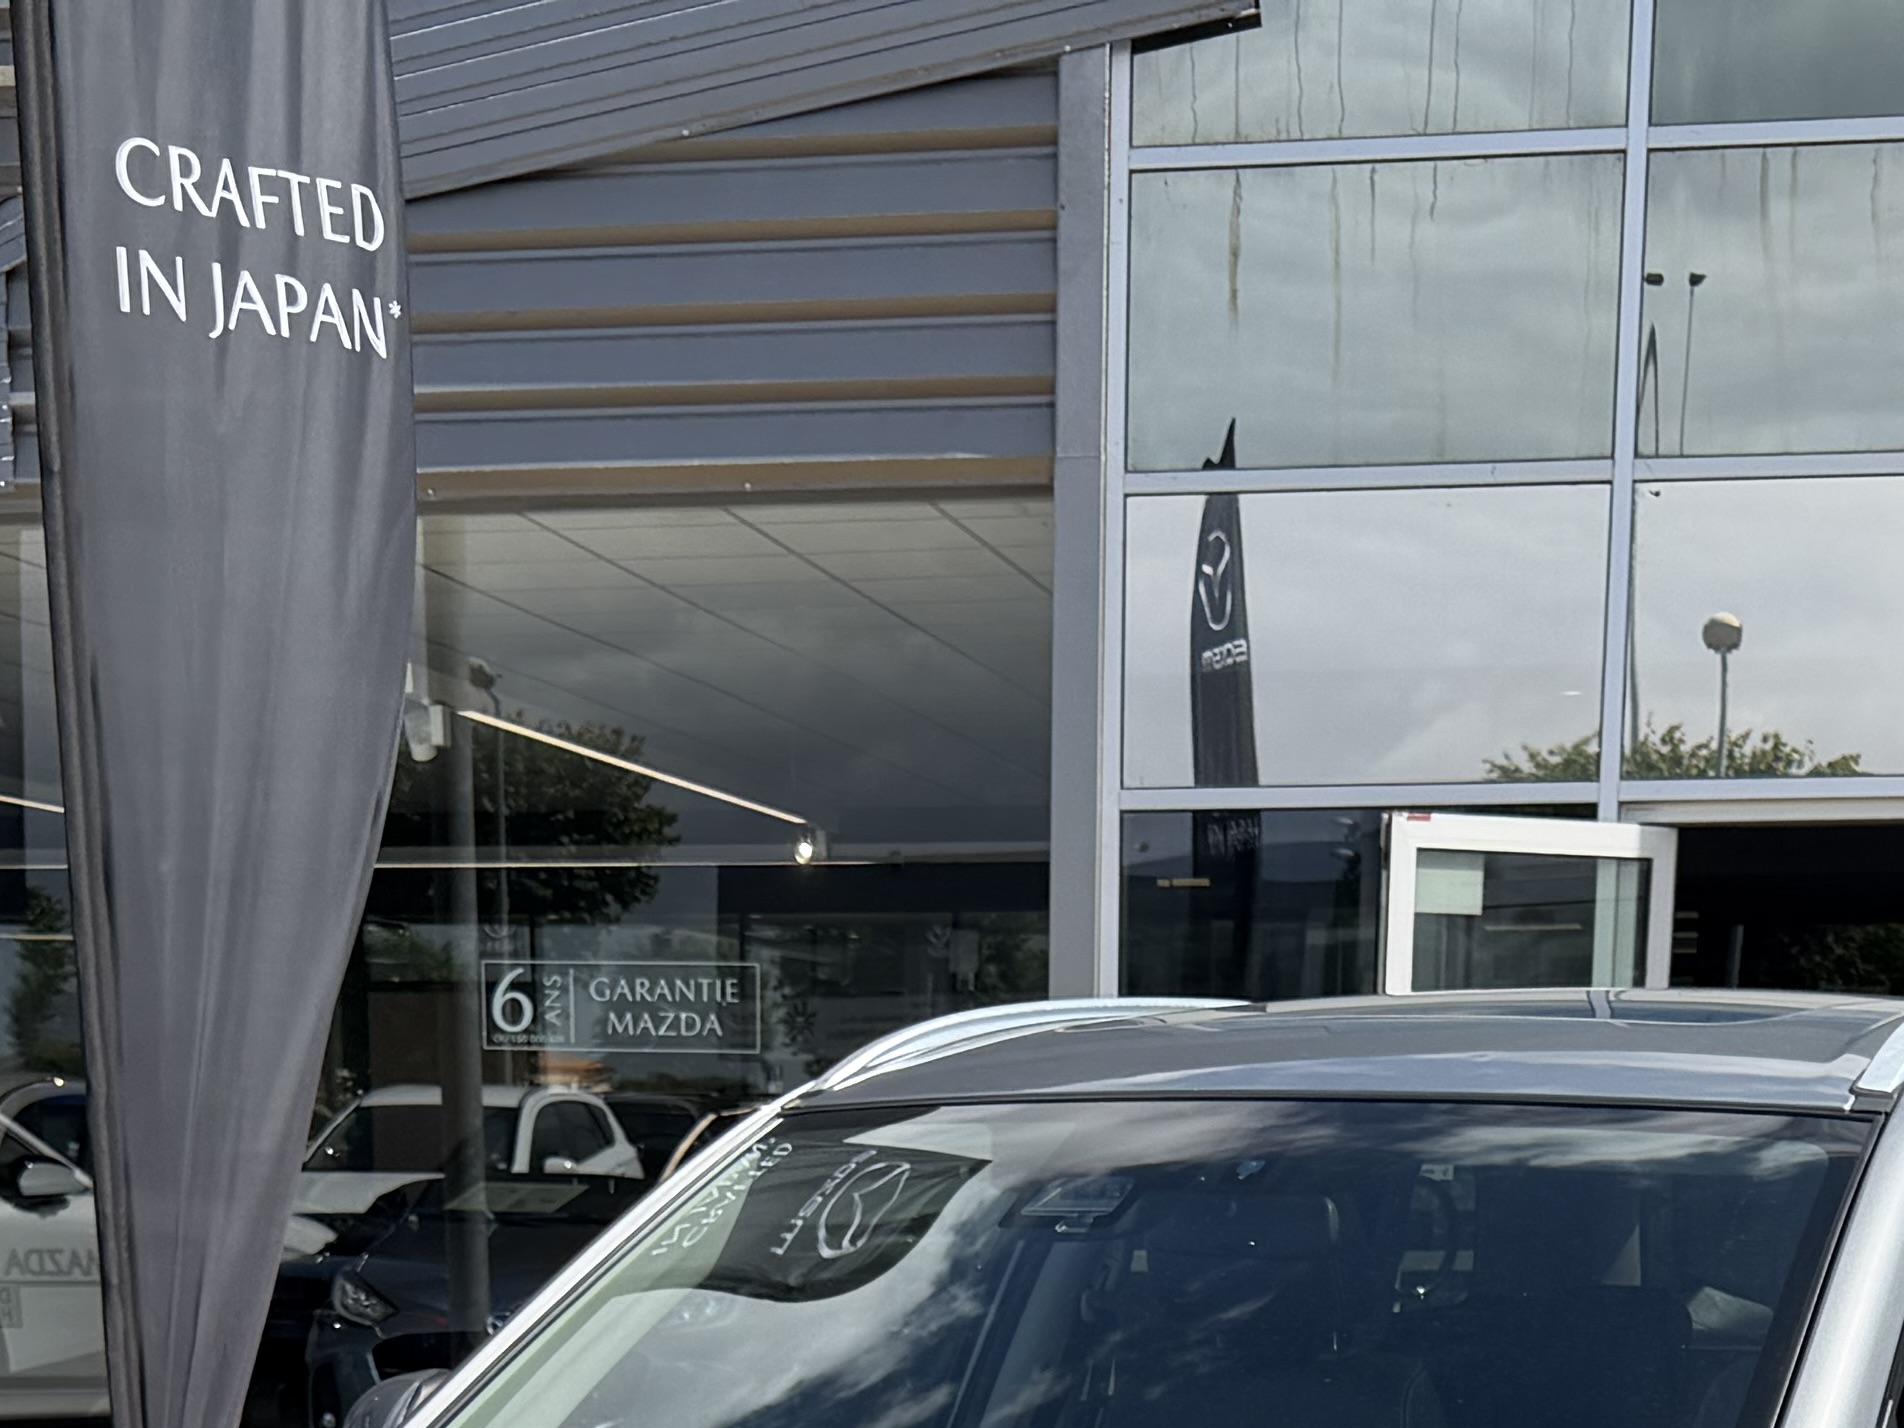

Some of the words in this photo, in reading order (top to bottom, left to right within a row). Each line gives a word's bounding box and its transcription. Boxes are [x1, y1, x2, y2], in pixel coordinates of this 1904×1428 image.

[115, 137, 386, 252] CRAFTED
[116, 247, 187, 322] IN
[492, 967, 534, 1033] 6
[542, 974, 563, 1027] ANS
[589, 976, 740, 1004] GARANTIE
[606, 1011, 724, 1037] MAZDA
